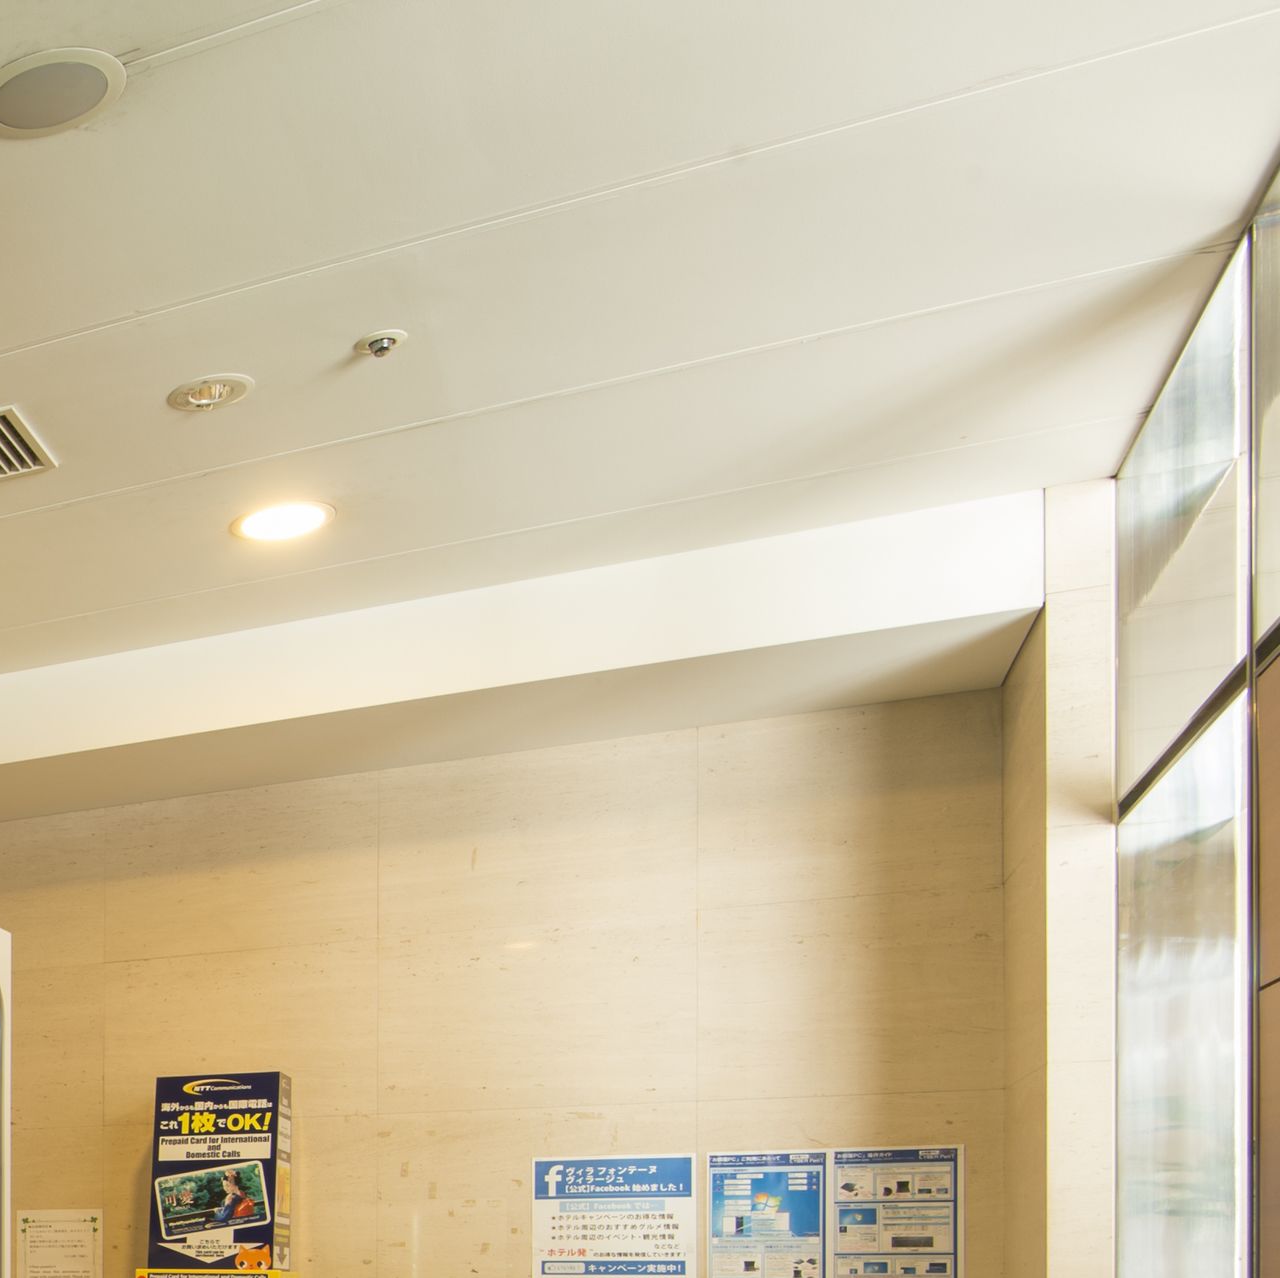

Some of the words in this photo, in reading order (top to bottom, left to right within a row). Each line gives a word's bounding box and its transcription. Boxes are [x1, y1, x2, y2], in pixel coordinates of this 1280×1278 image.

[161, 1138, 189, 1146] Prepaid
[190, 1137, 208, 1145] Card
[209, 1136, 220, 1144] for
[220, 1135, 270, 1143] International
[186, 1151, 220, 1159] Domestic
[222, 1150, 241, 1158] Calls
[565, 1167, 594, 1177] ヴィラ
[597, 1166, 657, 1175] フォンテーヌ
[544, 1165, 563, 1196] f
[565, 1175, 624, 1184] ヴィラージュ
